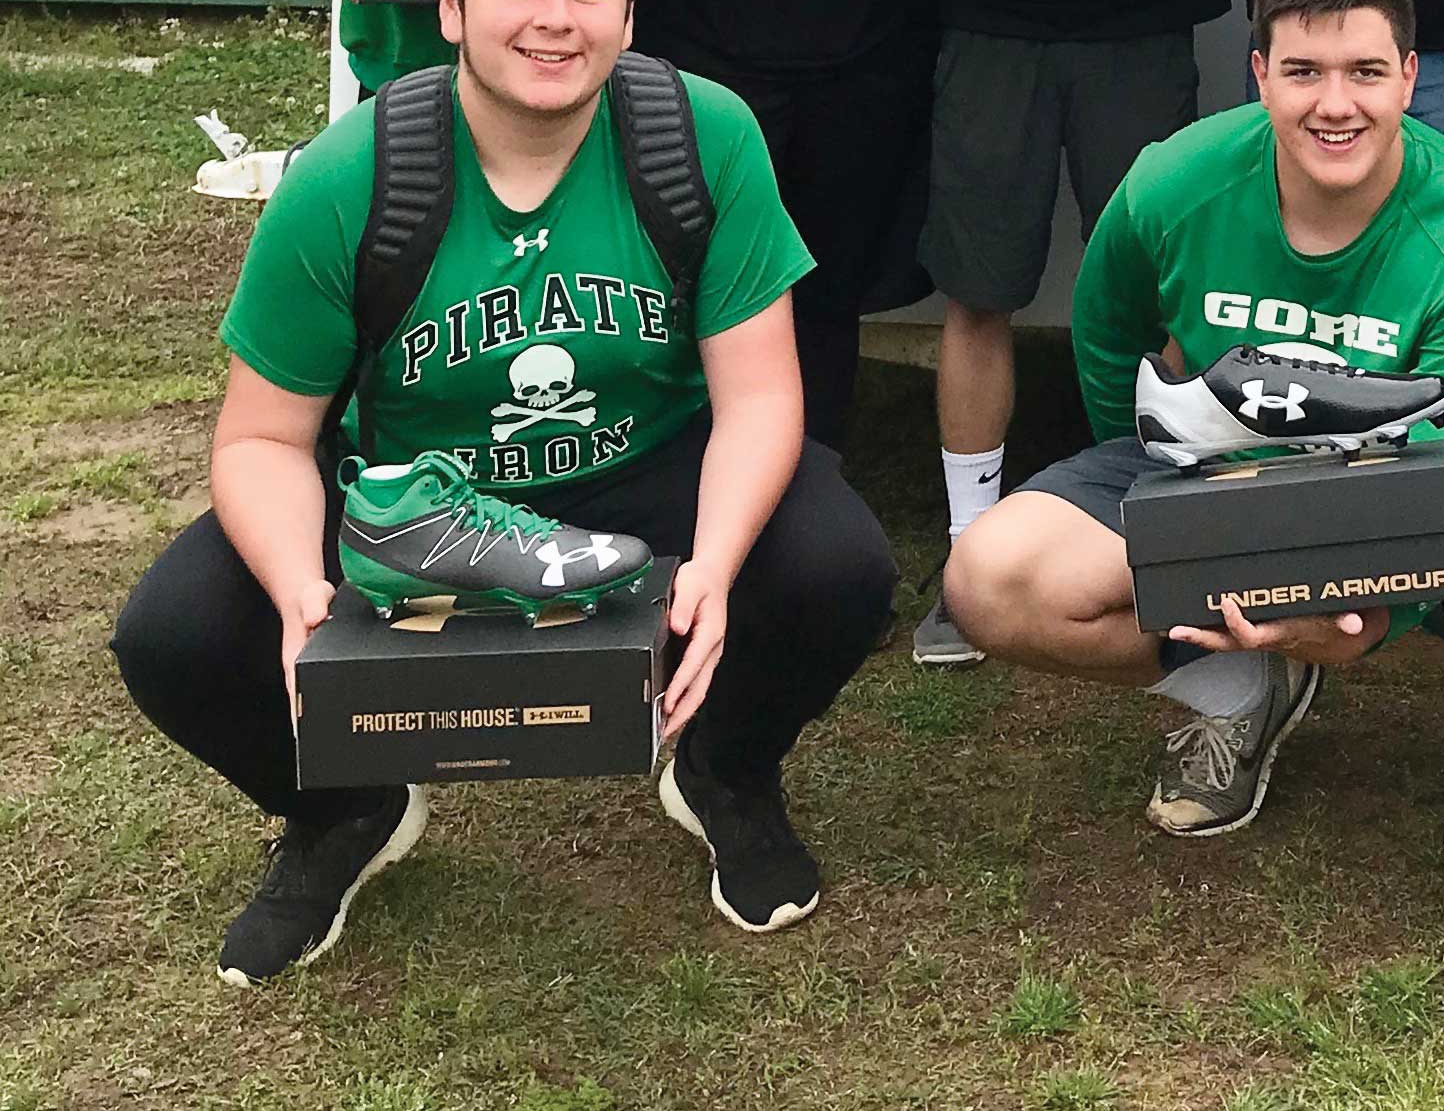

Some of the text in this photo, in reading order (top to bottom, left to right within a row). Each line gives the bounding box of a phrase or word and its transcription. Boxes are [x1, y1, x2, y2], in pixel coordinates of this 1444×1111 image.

[402, 273, 669, 386] PIRATE
[1204, 291, 1401, 358] GORE
[454, 416, 634, 482] IRON
[1207, 584, 1311, 611] UNDER
[352, 711, 425, 733] PROTECT
[428, 710, 458, 730] THIS
